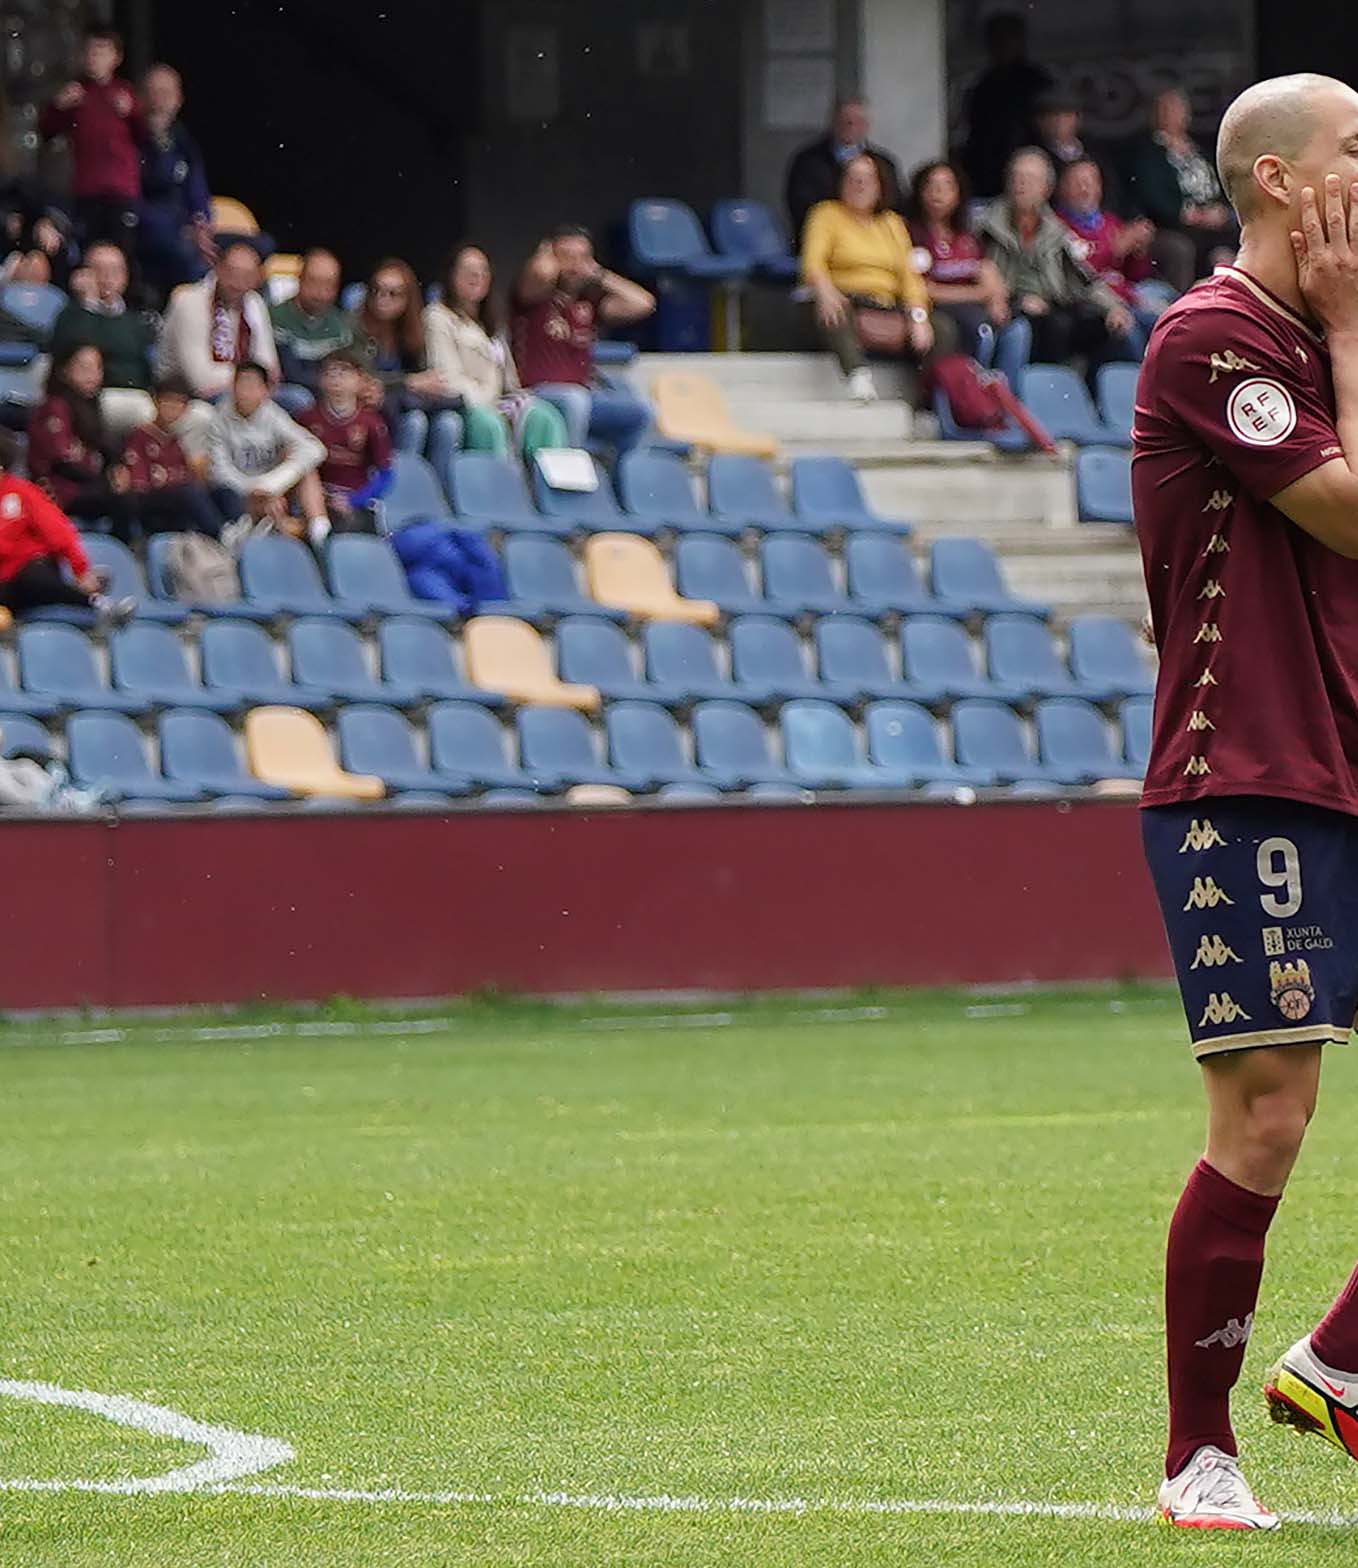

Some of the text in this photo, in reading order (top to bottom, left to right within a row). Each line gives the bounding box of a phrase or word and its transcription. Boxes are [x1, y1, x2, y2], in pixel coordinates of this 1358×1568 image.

[1256, 837, 1302, 918] 9
[1286, 925, 1323, 939] XUNTA
[1287, 939, 1303, 951] DE
